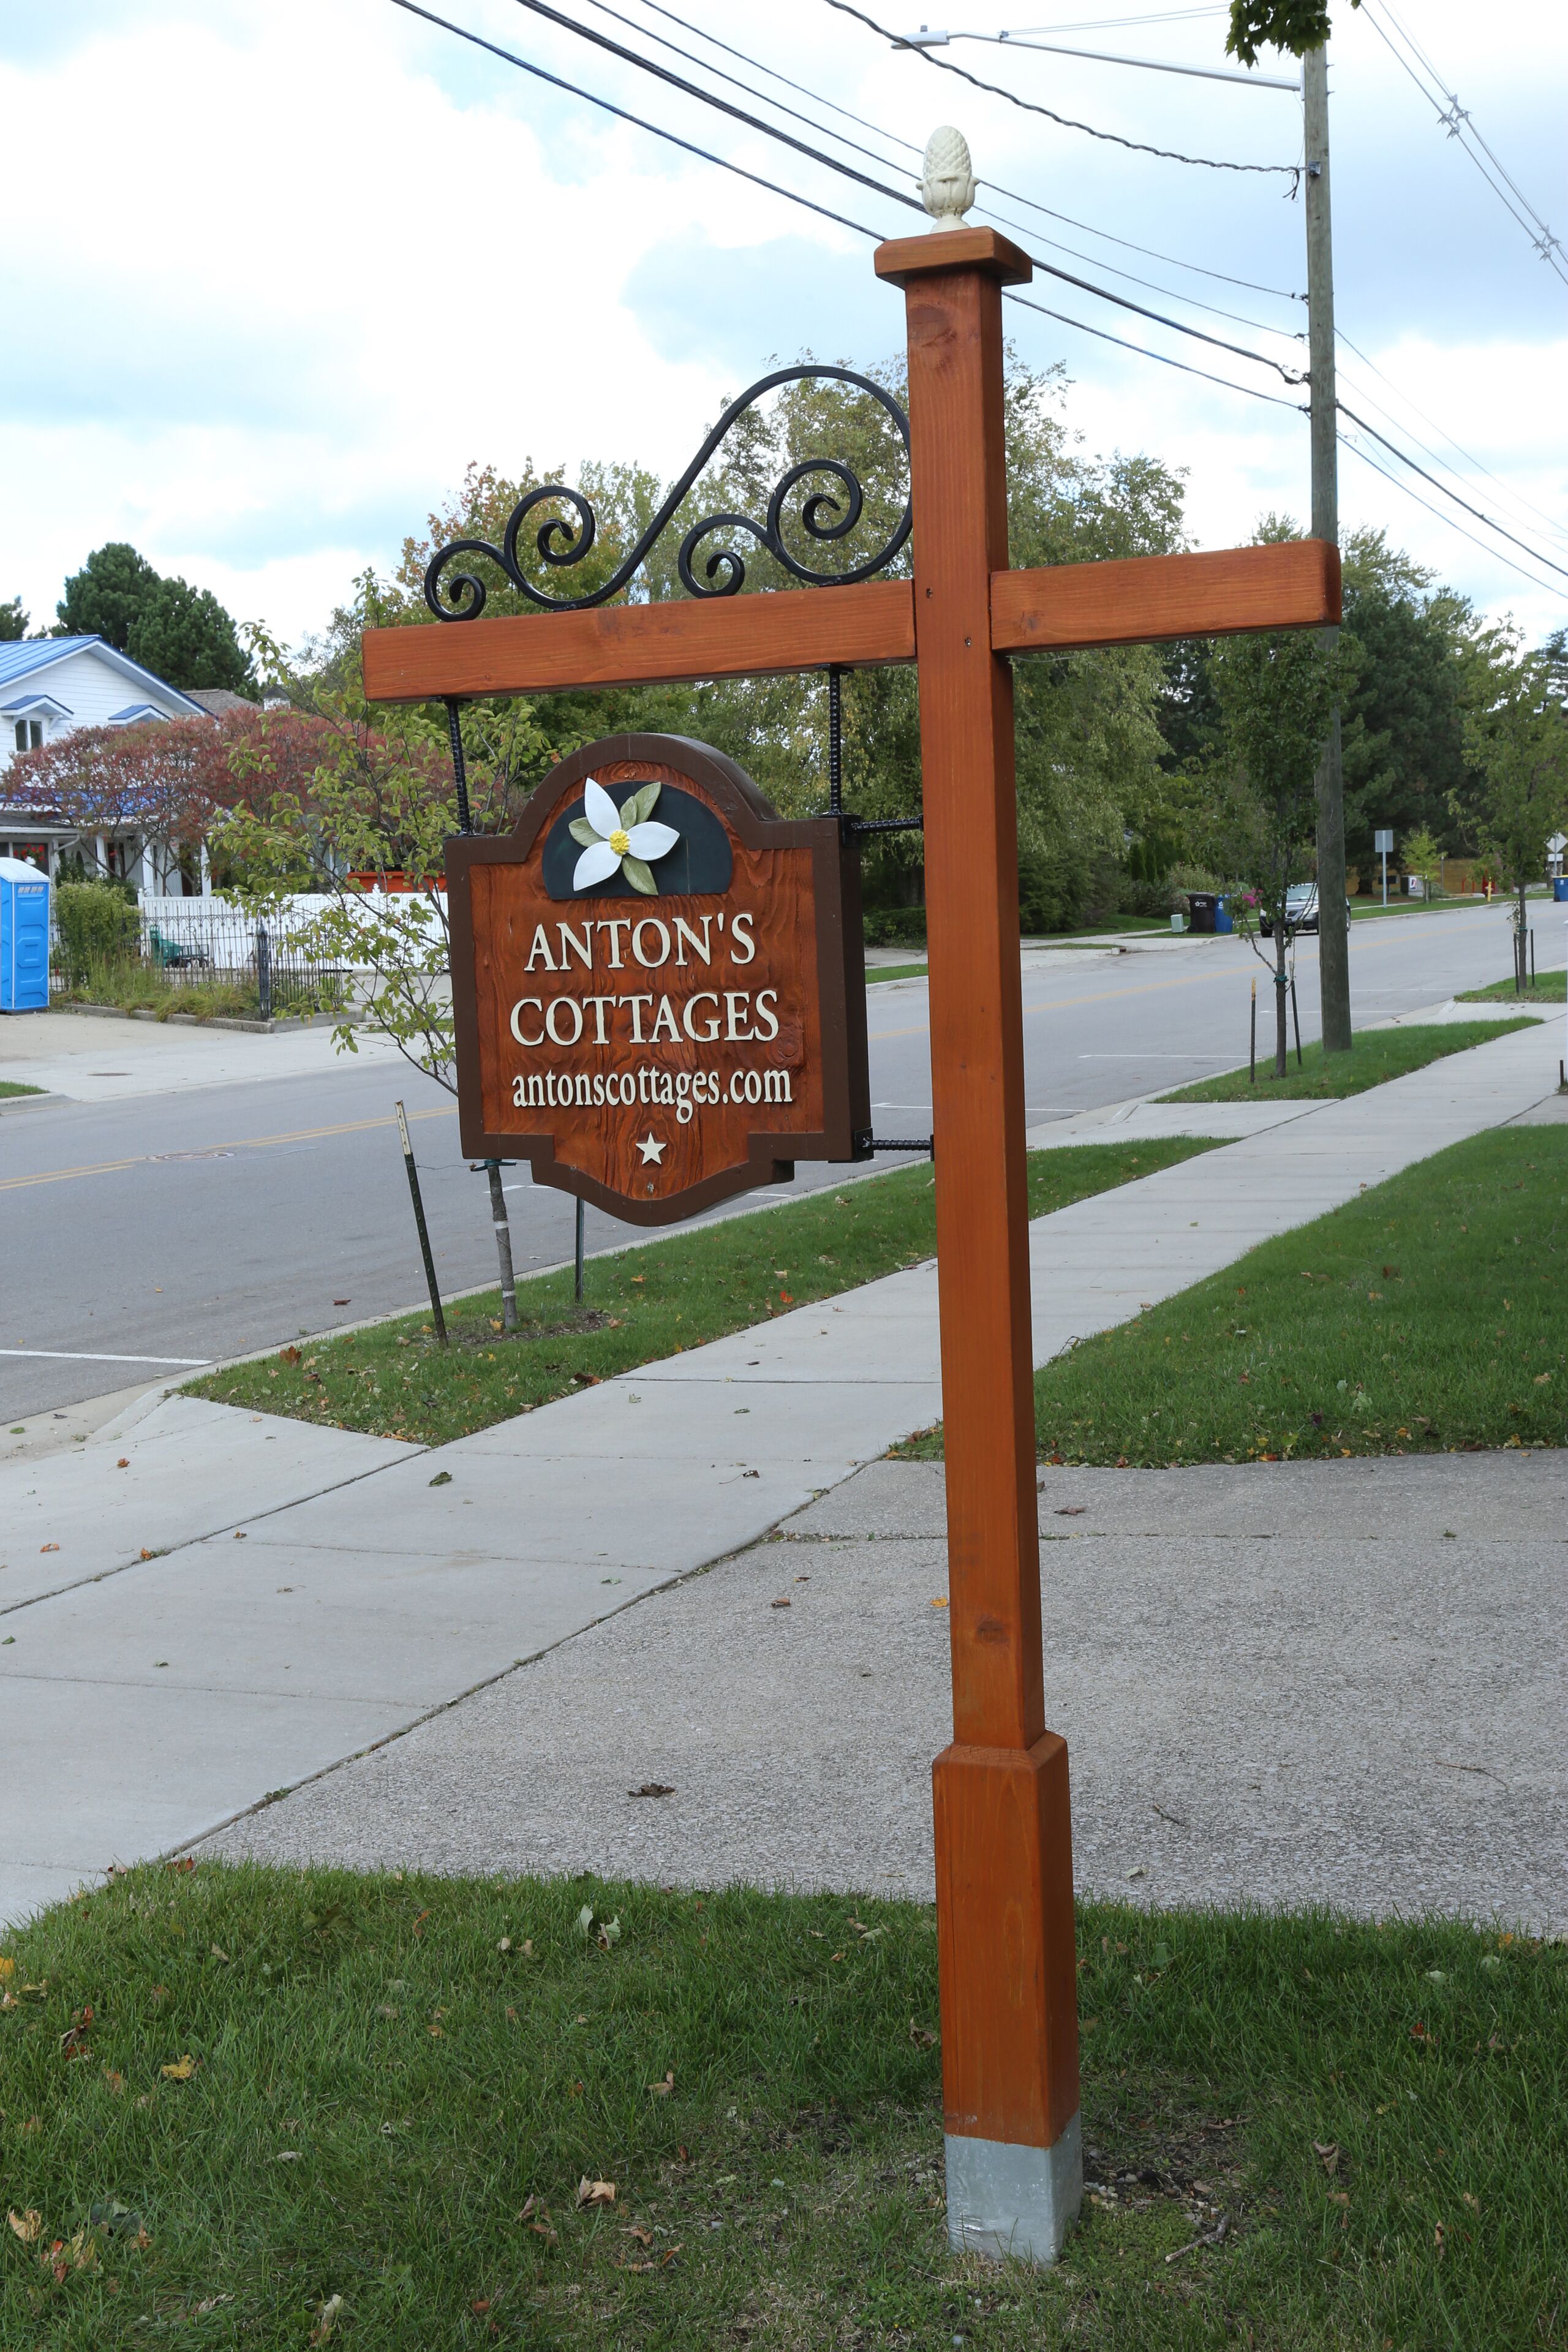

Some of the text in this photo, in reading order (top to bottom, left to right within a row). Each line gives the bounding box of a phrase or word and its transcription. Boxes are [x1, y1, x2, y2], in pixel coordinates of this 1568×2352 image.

[524, 913, 755, 971] ANTON'S
[510, 990, 779, 1046] COTTAGES
[512, 1066, 793, 1124] antonscottages.com
